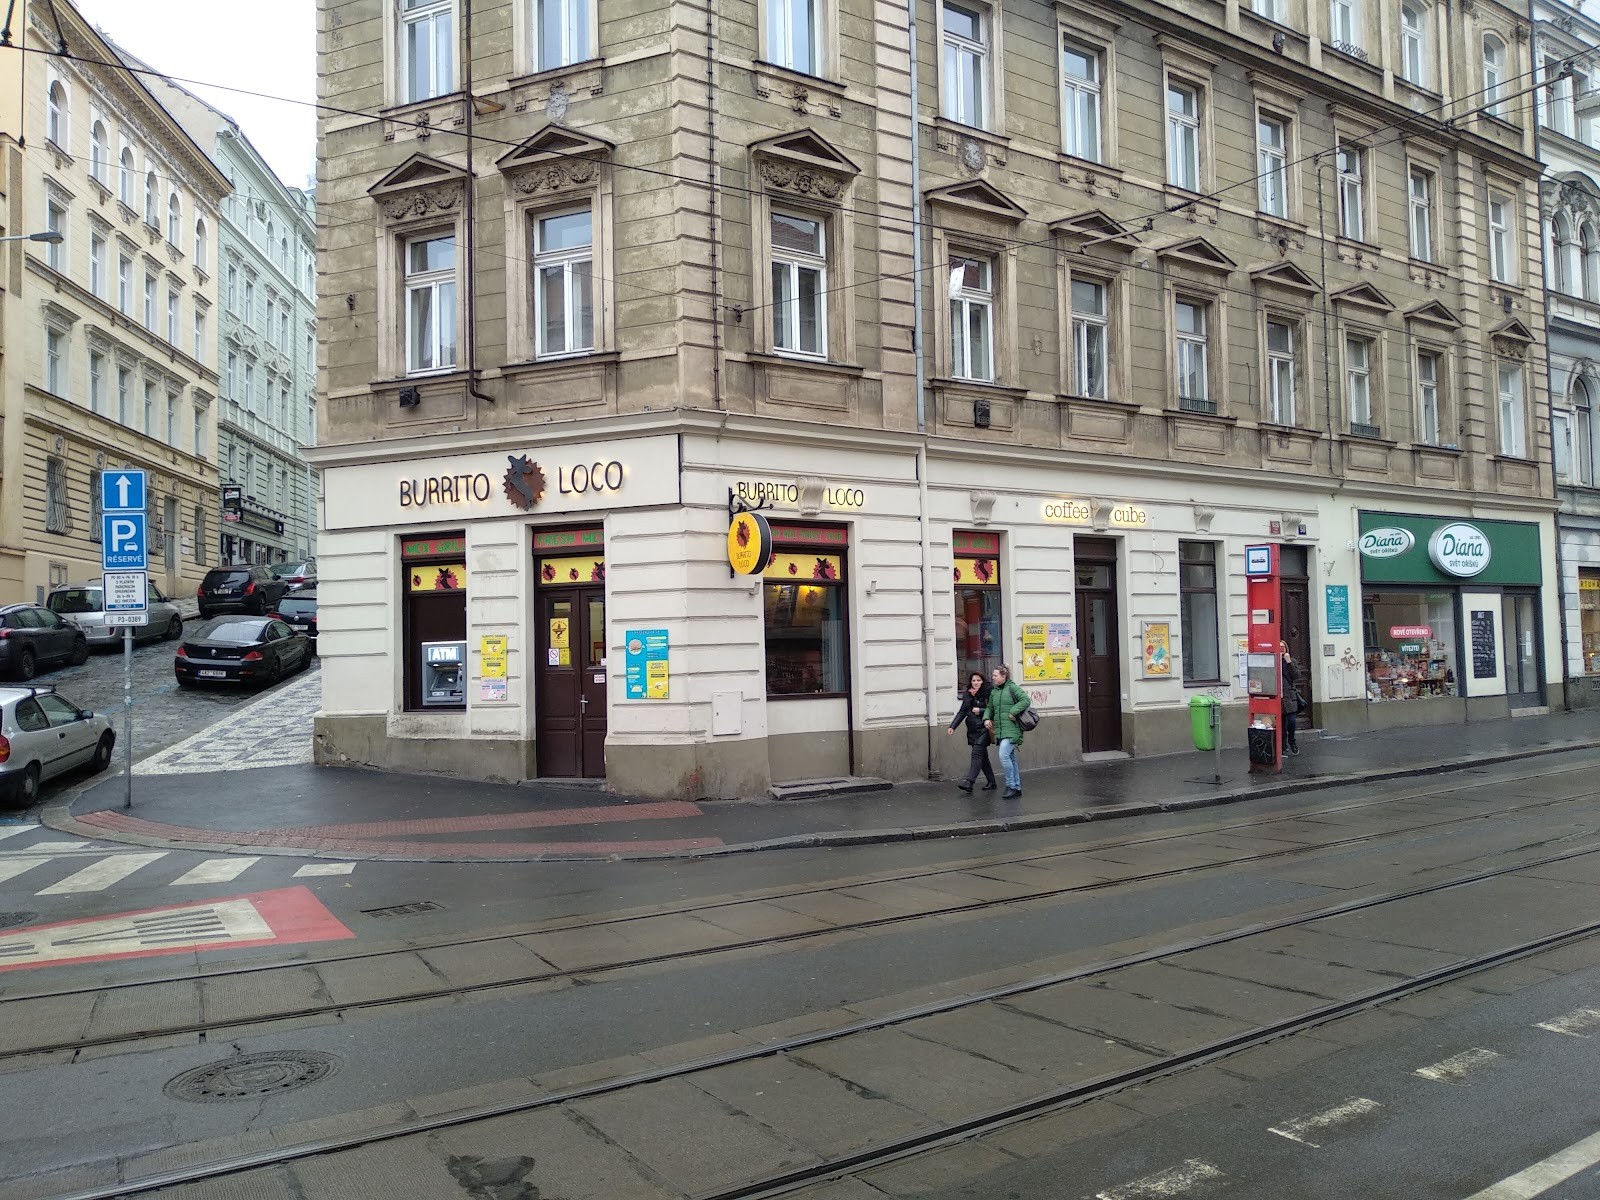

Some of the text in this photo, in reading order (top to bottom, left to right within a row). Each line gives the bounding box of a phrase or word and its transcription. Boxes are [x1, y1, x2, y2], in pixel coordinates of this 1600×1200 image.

[400, 461, 623, 506] BURRITO LOCO
[738, 481, 864, 507] BURRITO LOCO
[1045, 501, 1146, 523] coffee cube
[111, 519, 136, 552] P
[537, 533, 575, 546] FRESH
[1364, 534, 1404, 548] Diana
[1442, 533, 1484, 557] Diana
[431, 648, 457, 660] ATM
